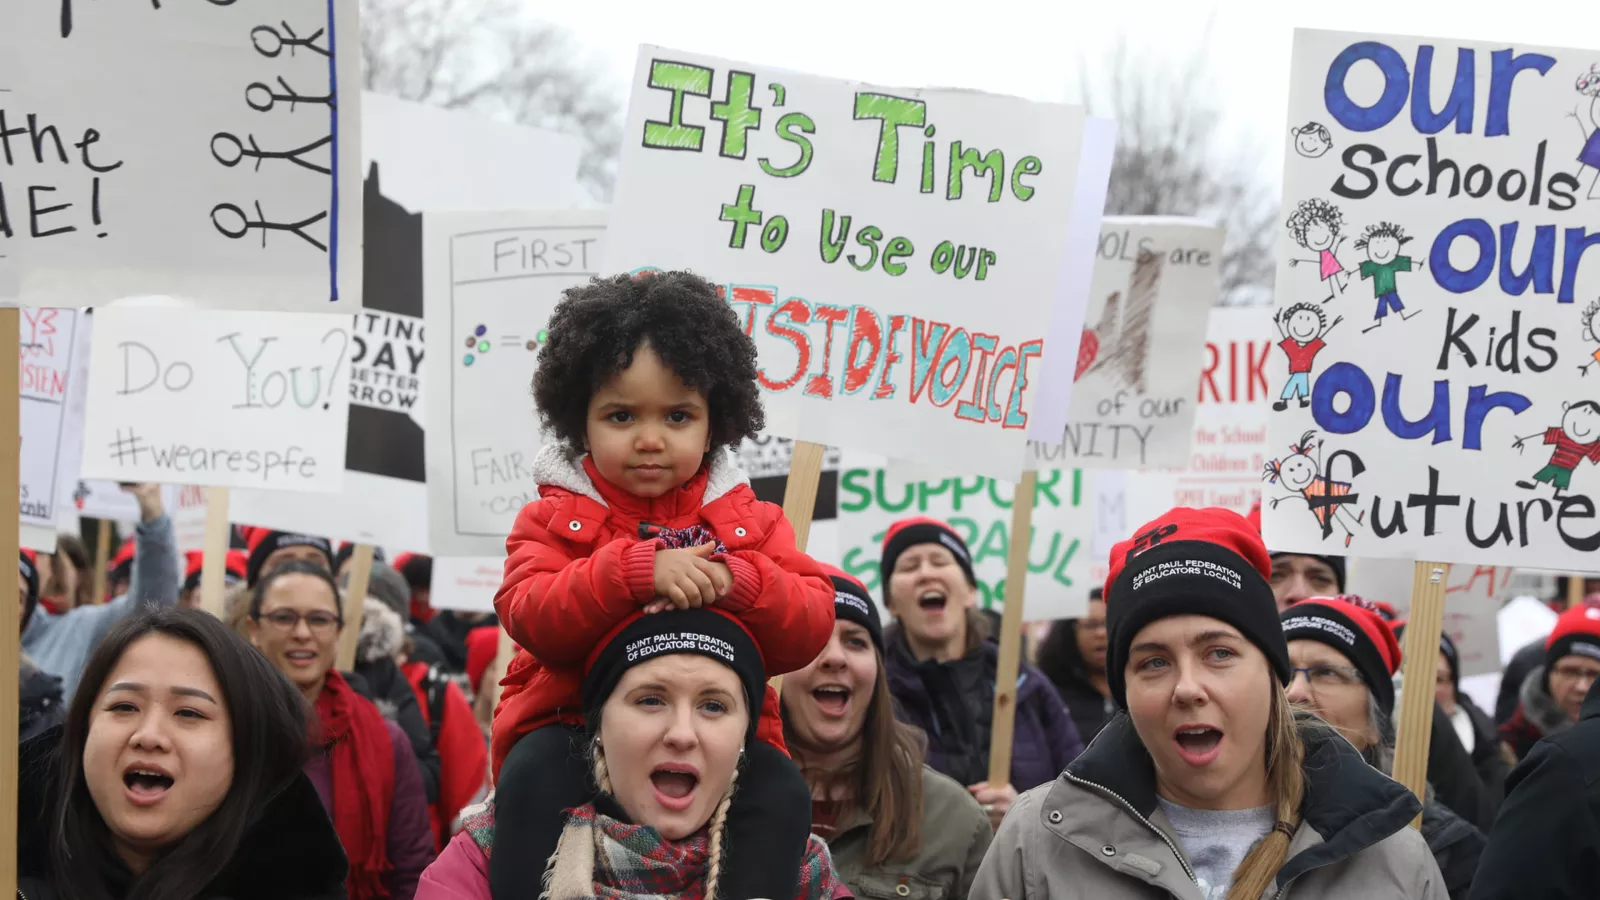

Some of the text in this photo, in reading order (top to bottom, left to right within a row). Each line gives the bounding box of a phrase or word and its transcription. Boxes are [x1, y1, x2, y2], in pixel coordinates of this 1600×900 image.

[0, 109, 123, 173] the
[642, 58, 1042, 203] It's Time
[1330, 137, 1580, 211] Schools
[0, 177, 108, 238] E!
[719, 184, 996, 281] to Use our
[493, 237, 597, 272] FIRST
[1096, 229, 1212, 268] OLS are
[116, 327, 348, 411] Do You?
[632, 267, 1044, 430] TSIDE VOICE
[1436, 307, 1558, 374] Kids
[1097, 390, 1186, 419] of our
[108, 426, 318, 481] #wearespfe
[471, 447, 531, 486] FAIR
[1309, 450, 1600, 552] future
[1132, 559, 1242, 584] SAINT PAUL FEDERATION
[1132, 580, 1144, 590] OF
[1144, 567, 1201, 583] EDUCATORS
[625, 632, 735, 653] SAINT PAUL FEDERATION
[627, 651, 639, 661] OF
[640, 641, 696, 656] EDUCATORS
